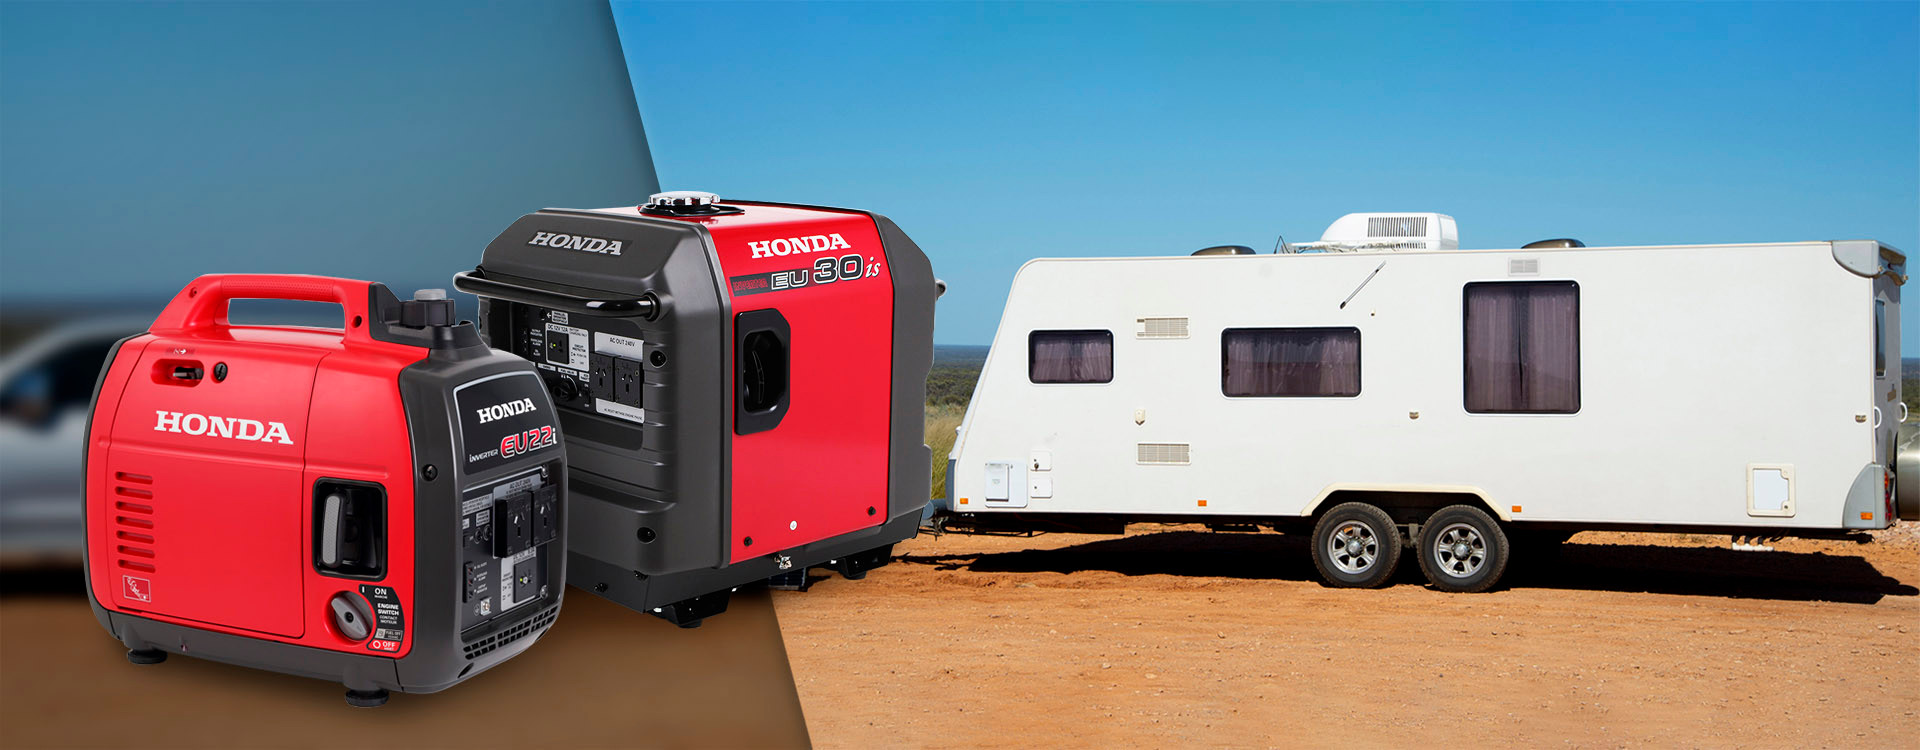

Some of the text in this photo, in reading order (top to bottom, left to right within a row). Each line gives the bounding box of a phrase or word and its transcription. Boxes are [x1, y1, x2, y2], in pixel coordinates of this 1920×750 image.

[528, 231, 623, 256] HONDA
[747, 233, 851, 259] HONDA
[476, 397, 537, 424] HONDA
[154, 410, 294, 445] HONDA
[501, 425, 557, 459] EU22i
[374, 587, 387, 595] ON
[377, 602, 399, 610] ENGINE
